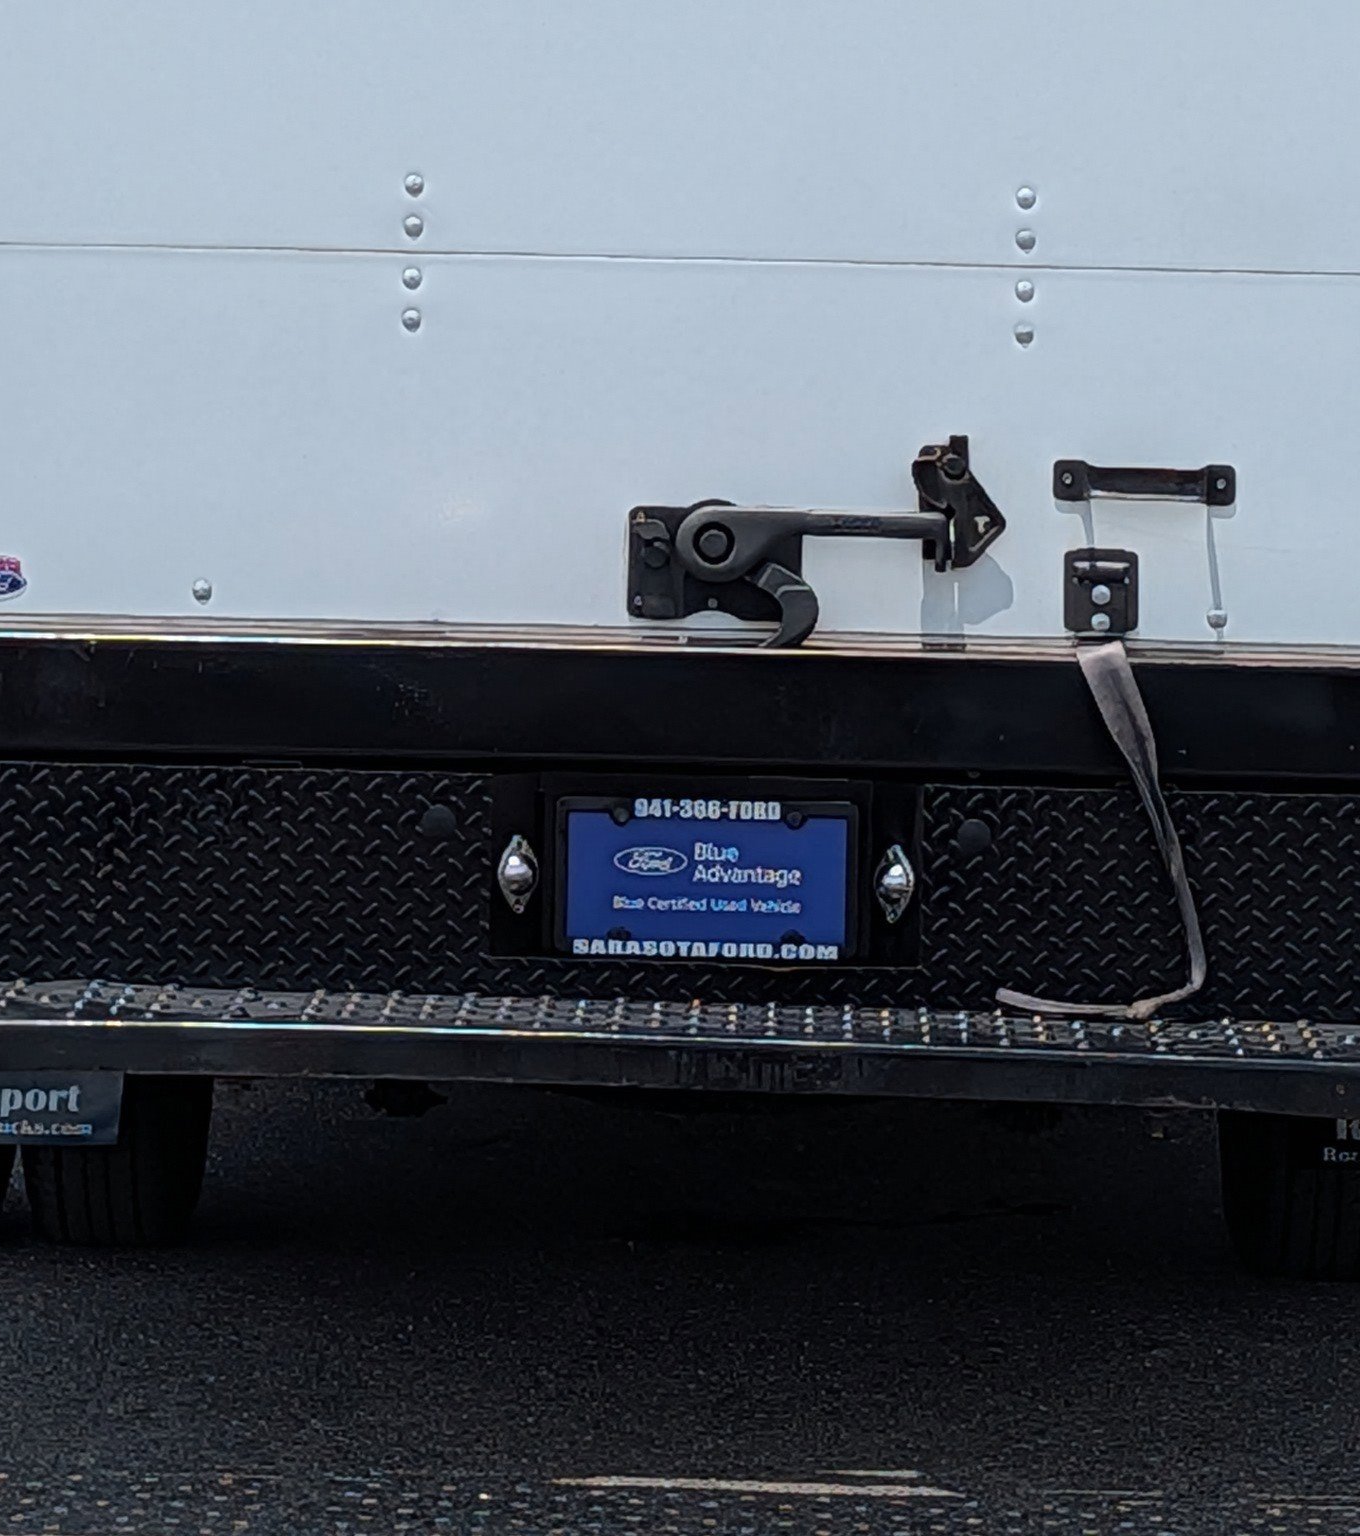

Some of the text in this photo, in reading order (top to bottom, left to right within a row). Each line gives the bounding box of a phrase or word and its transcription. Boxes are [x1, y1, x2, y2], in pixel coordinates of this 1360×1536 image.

[693, 842, 739, 863] Blue
[692, 865, 802, 889] Advantage
[647, 896, 707, 912] Certified
[750, 898, 802, 915] Vehicle
[573, 938, 838, 961] SARASOTAFORD.COM
